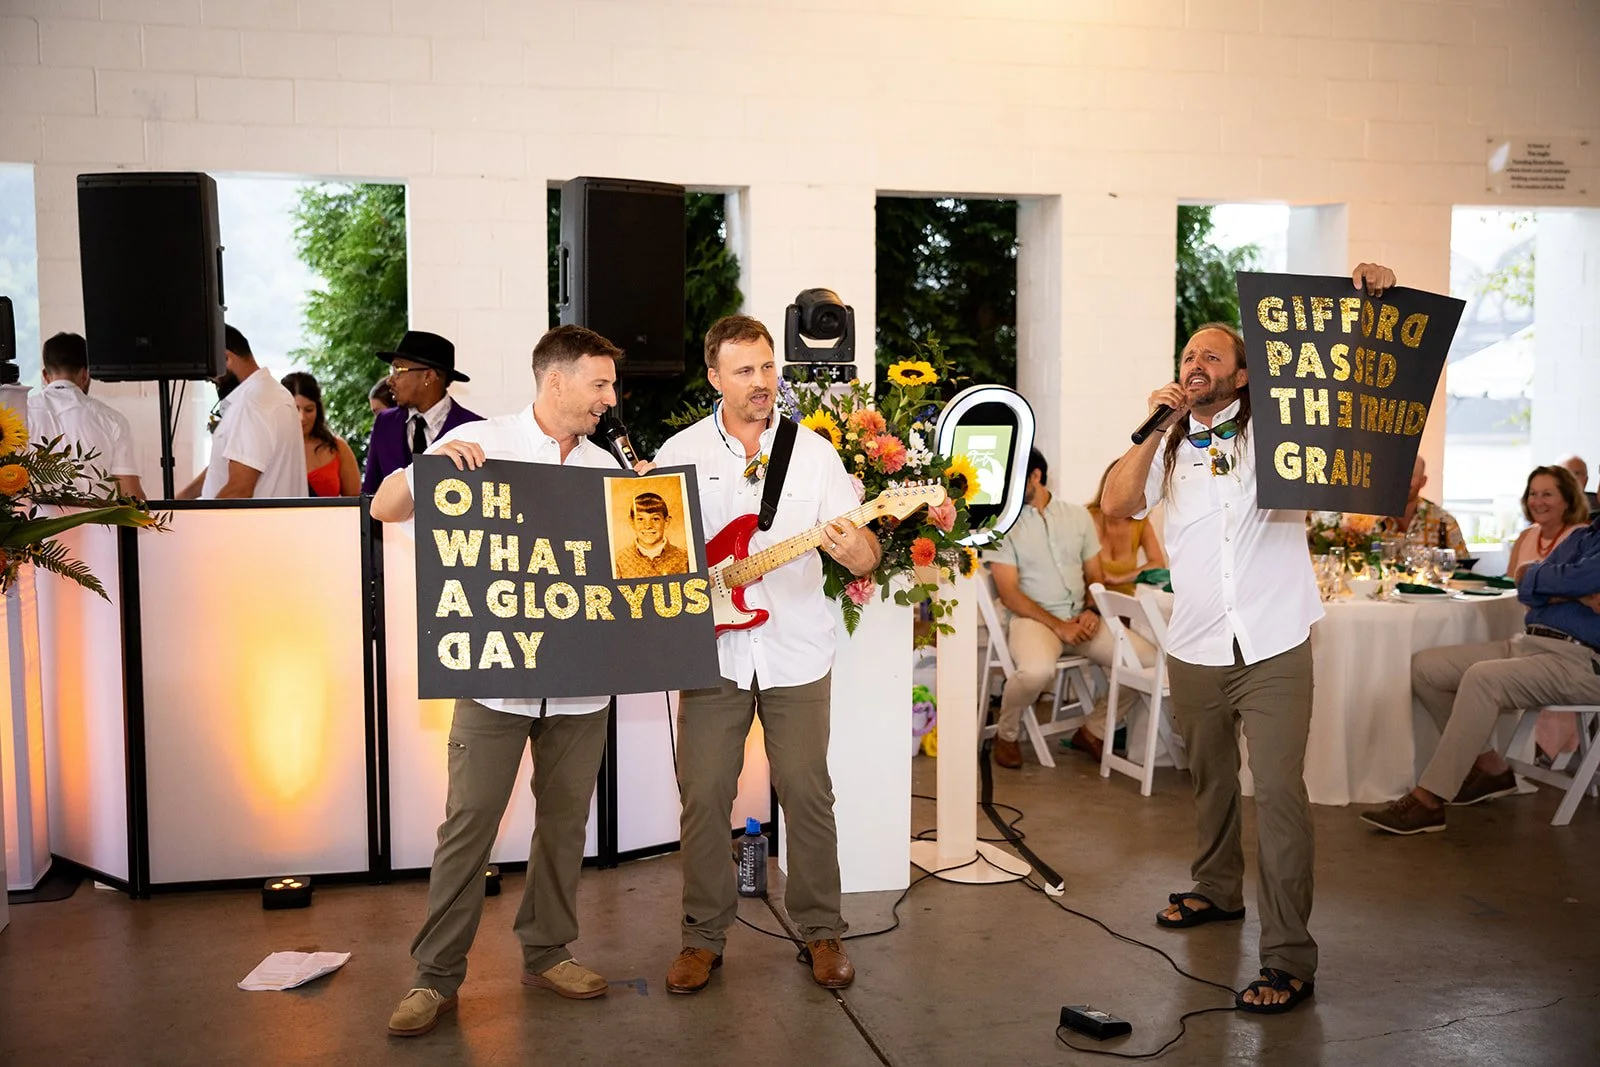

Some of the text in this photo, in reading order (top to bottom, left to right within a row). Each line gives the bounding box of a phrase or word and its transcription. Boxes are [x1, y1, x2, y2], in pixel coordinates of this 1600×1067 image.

[1257, 295, 1429, 348] GIFFORD
[1265, 340, 1397, 389] PASSED
[1270, 387, 1428, 436] THE TRHID
[1273, 441, 1373, 488] GRADE
[433, 478, 524, 524] OH,
[432, 529, 592, 576] WHAT
[435, 578, 711, 621] A GLORYUS
[437, 631, 545, 671] DAY
